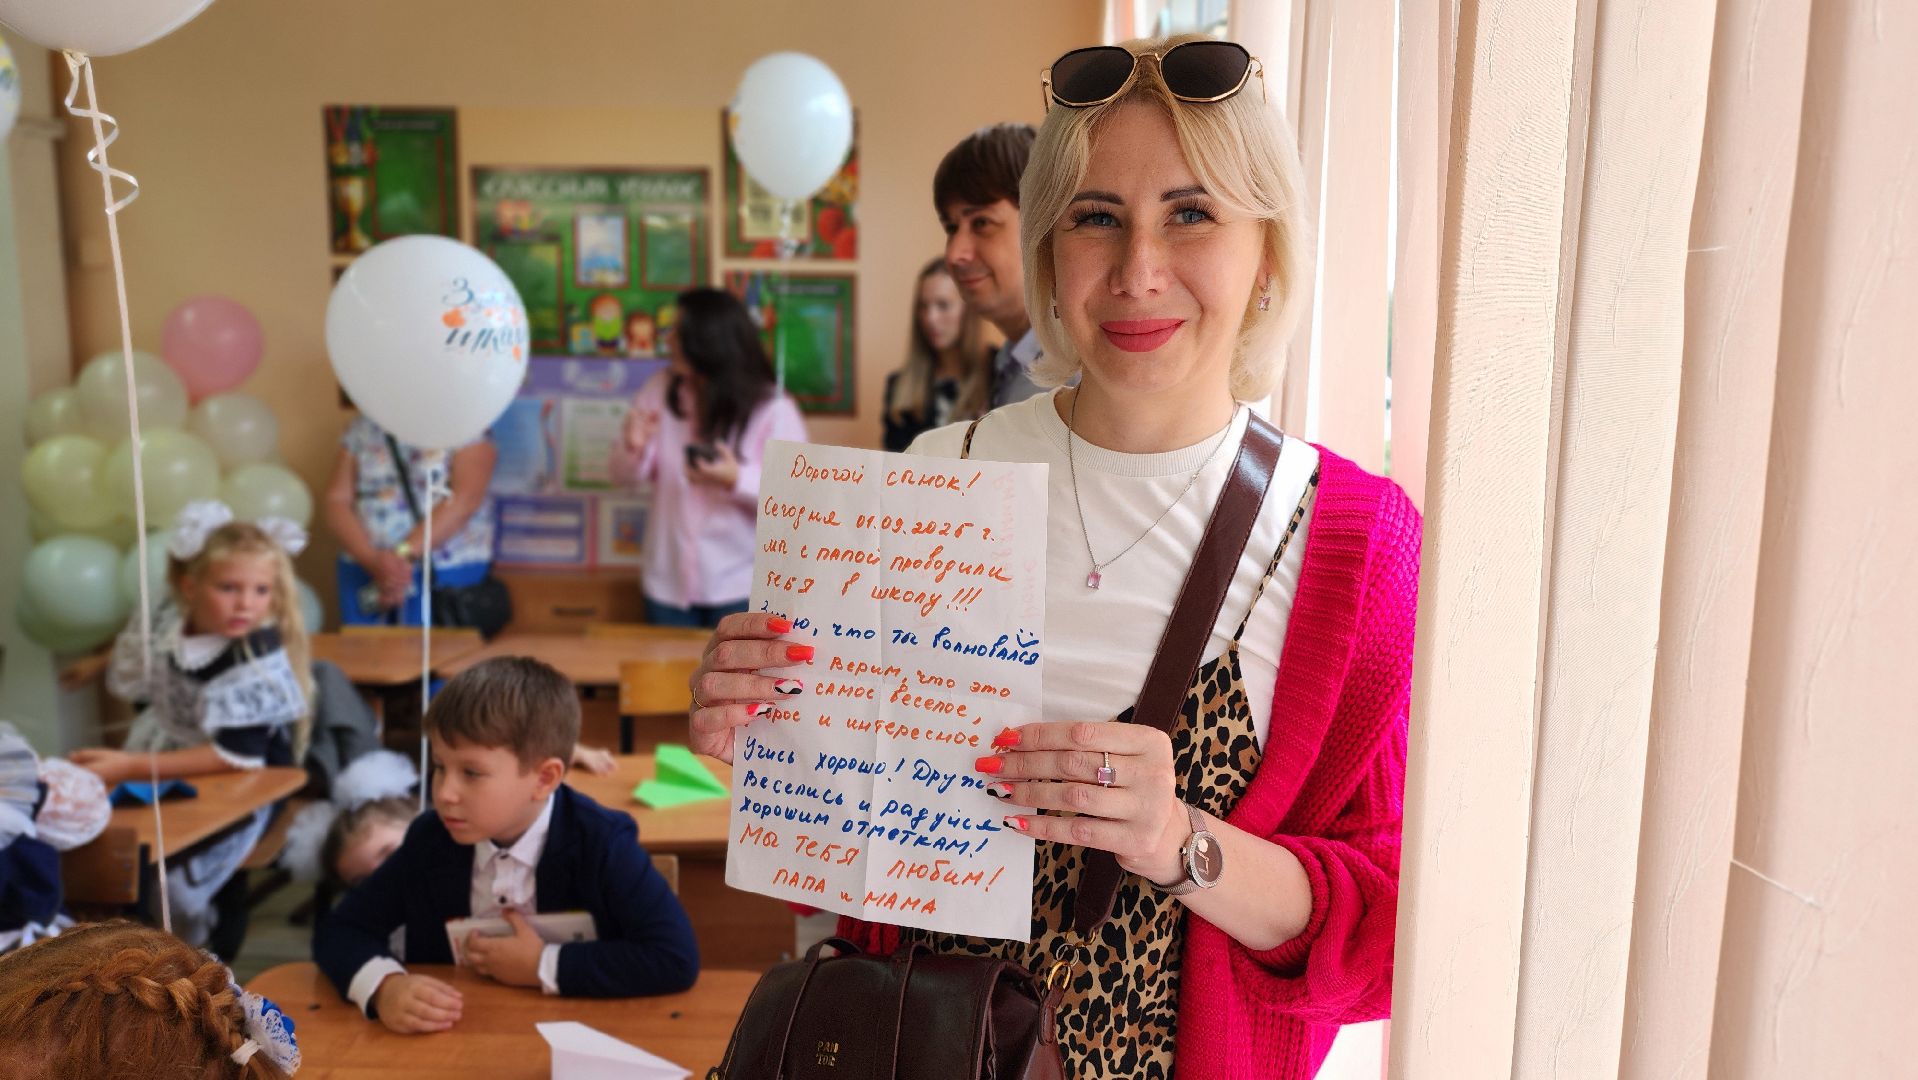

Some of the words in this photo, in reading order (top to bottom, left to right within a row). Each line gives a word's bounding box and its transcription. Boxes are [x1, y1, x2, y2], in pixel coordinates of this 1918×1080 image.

[790, 454, 864, 486] Дорогой
[887, 470, 981, 496] сынок!
[764, 496, 840, 530] Сегодня
[856, 514, 974, 539] 01.09.2025
[982, 528, 995, 542] г.
[801, 545, 808, 560] с
[889, 546, 1013, 582] проводили
[842, 572, 860, 597] в
[871, 587, 982, 617] школу!!!
[833, 623, 875, 640] что
[892, 629, 919, 646] ты
[931, 627, 1040, 665] волновался
[916, 670, 955, 690] что
[970, 681, 1011, 698] это
[743, 735, 795, 764] Учись
[819, 714, 831, 728] и
[847, 717, 980, 748] интересное
[743, 769, 844, 805] Веселись
[859, 799, 871, 813] и
[880, 798, 1003, 833] радуйся
[739, 823, 780, 848] Мы
[840, 890, 853, 903] и
